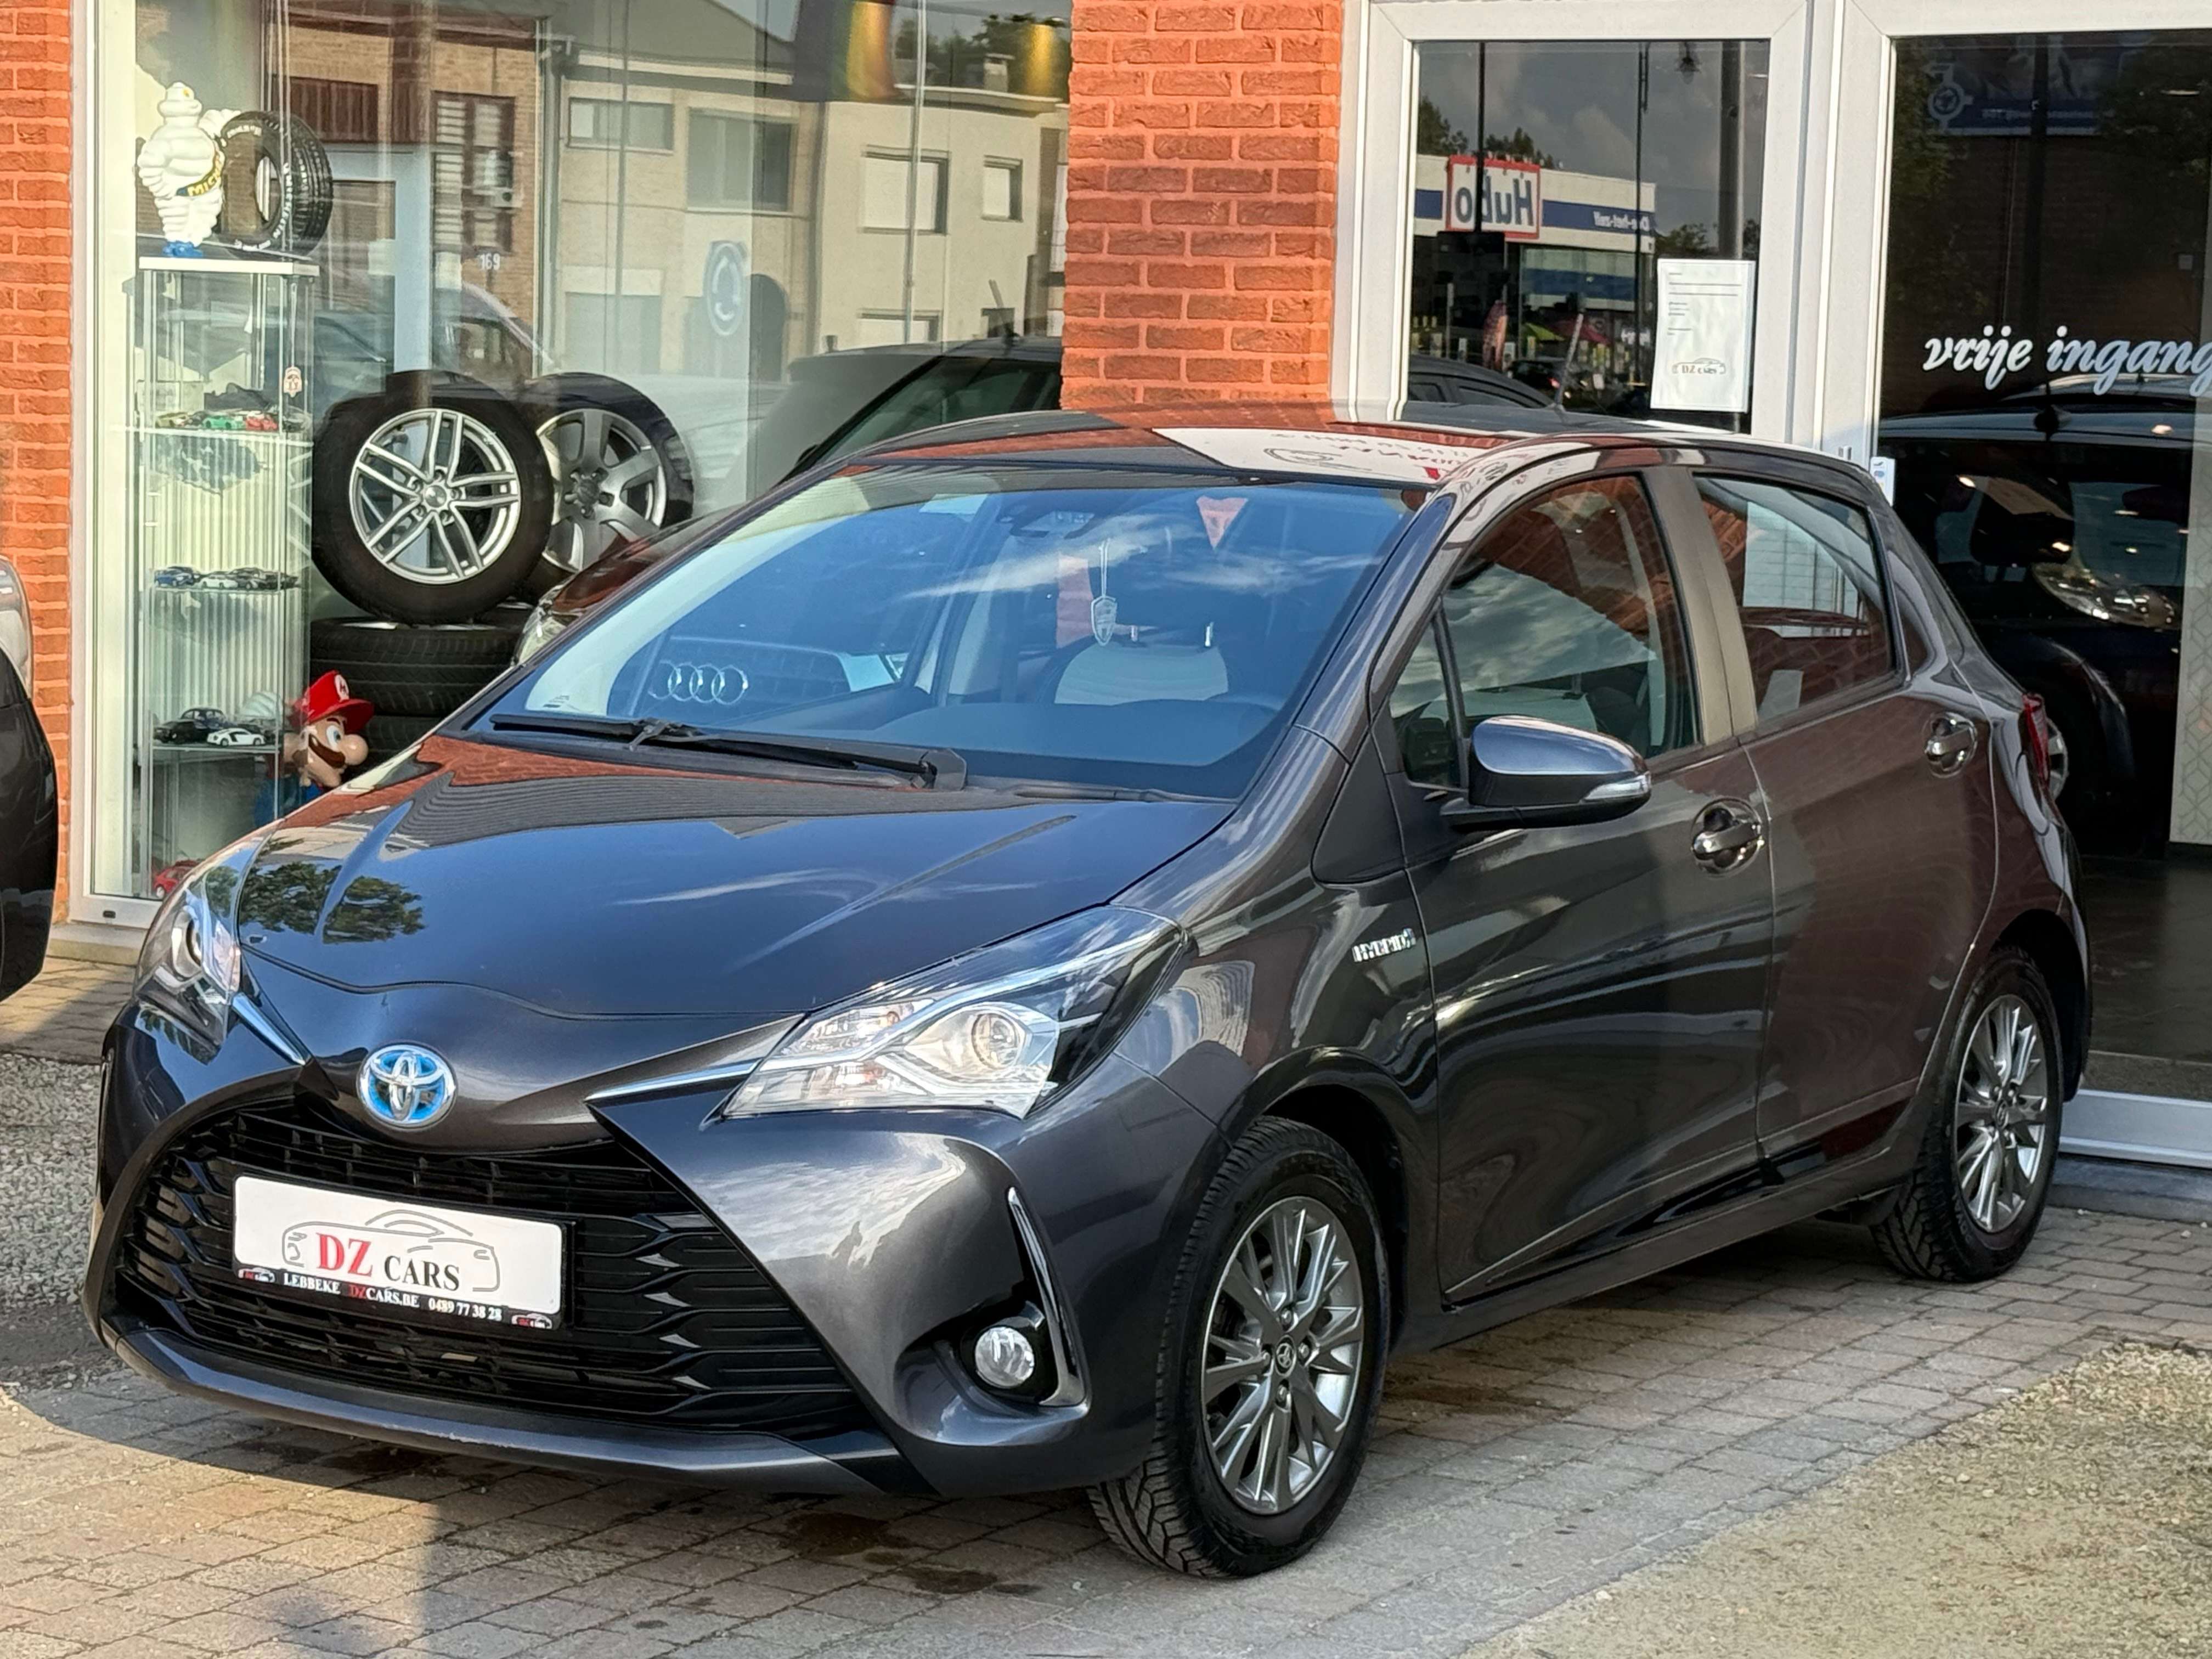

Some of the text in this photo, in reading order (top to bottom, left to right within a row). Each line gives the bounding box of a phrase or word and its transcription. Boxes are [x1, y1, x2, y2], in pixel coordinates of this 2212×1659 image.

[478, 253, 500, 270] 169
[1922, 325, 2212, 397] vrije ingang
[316, 1232, 460, 1291] DZ CARS
[284, 1273, 341, 1294] LEBBEKE
[456, 1302, 470, 1316] 77
[472, 1305, 486, 1319] 38
[487, 1307, 503, 1322] 28
